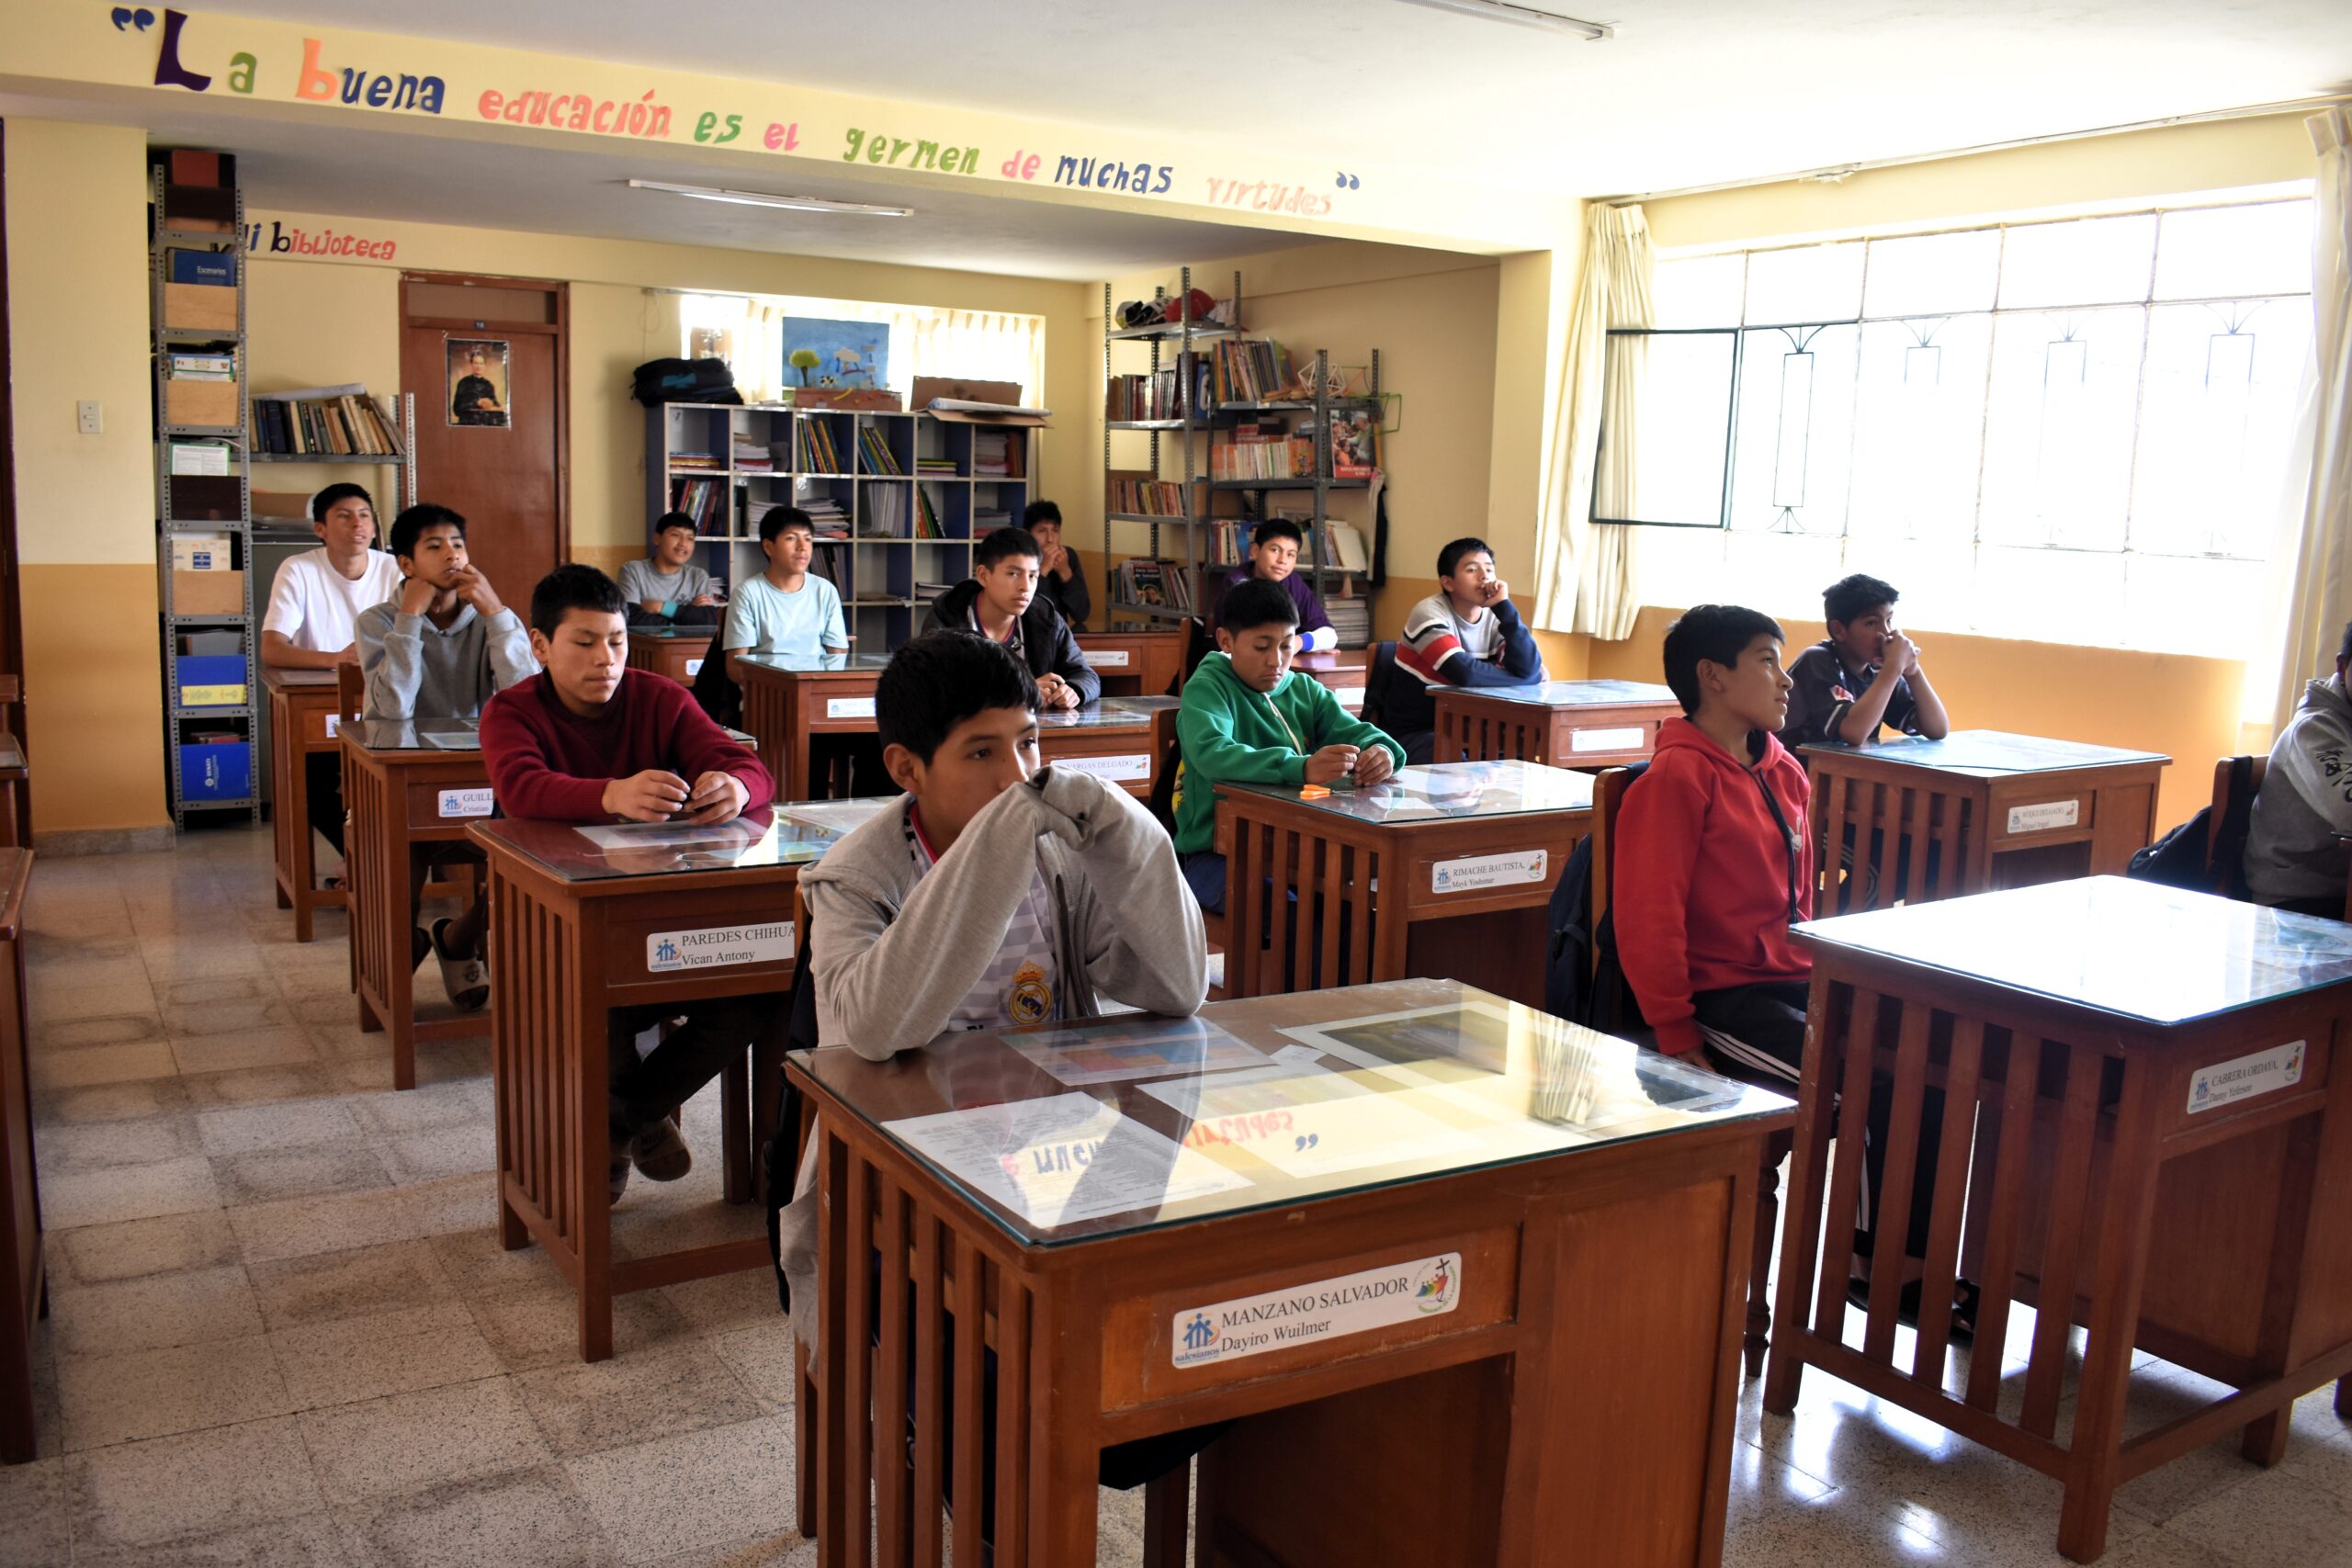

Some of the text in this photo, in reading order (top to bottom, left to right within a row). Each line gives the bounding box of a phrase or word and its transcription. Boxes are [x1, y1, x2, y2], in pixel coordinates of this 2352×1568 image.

[295, 37, 446, 114] buena
[478, 89, 672, 138] educación
[694, 111, 742, 144] es
[763, 122, 799, 152] el
[843, 128, 980, 175] germen
[1001, 150, 1042, 180] de
[1055, 154, 1173, 194] muchas
[270, 221, 396, 261] biblioteca
[197, 265, 227, 276] Escenarios
[1453, 865, 1487, 877] RIMACHE
[682, 931, 741, 947] PAREDES
[682, 950, 755, 966] Vican Antony
[2211, 1068, 2246, 1087] CABRERA
[1221, 1295, 1315, 1328] MANZANO
[1320, 1277, 1409, 1309] SALVADOR
[1221, 1320, 1331, 1352] Dayiro Wuilmer
[1175, 1348, 1220, 1361] salesianos
